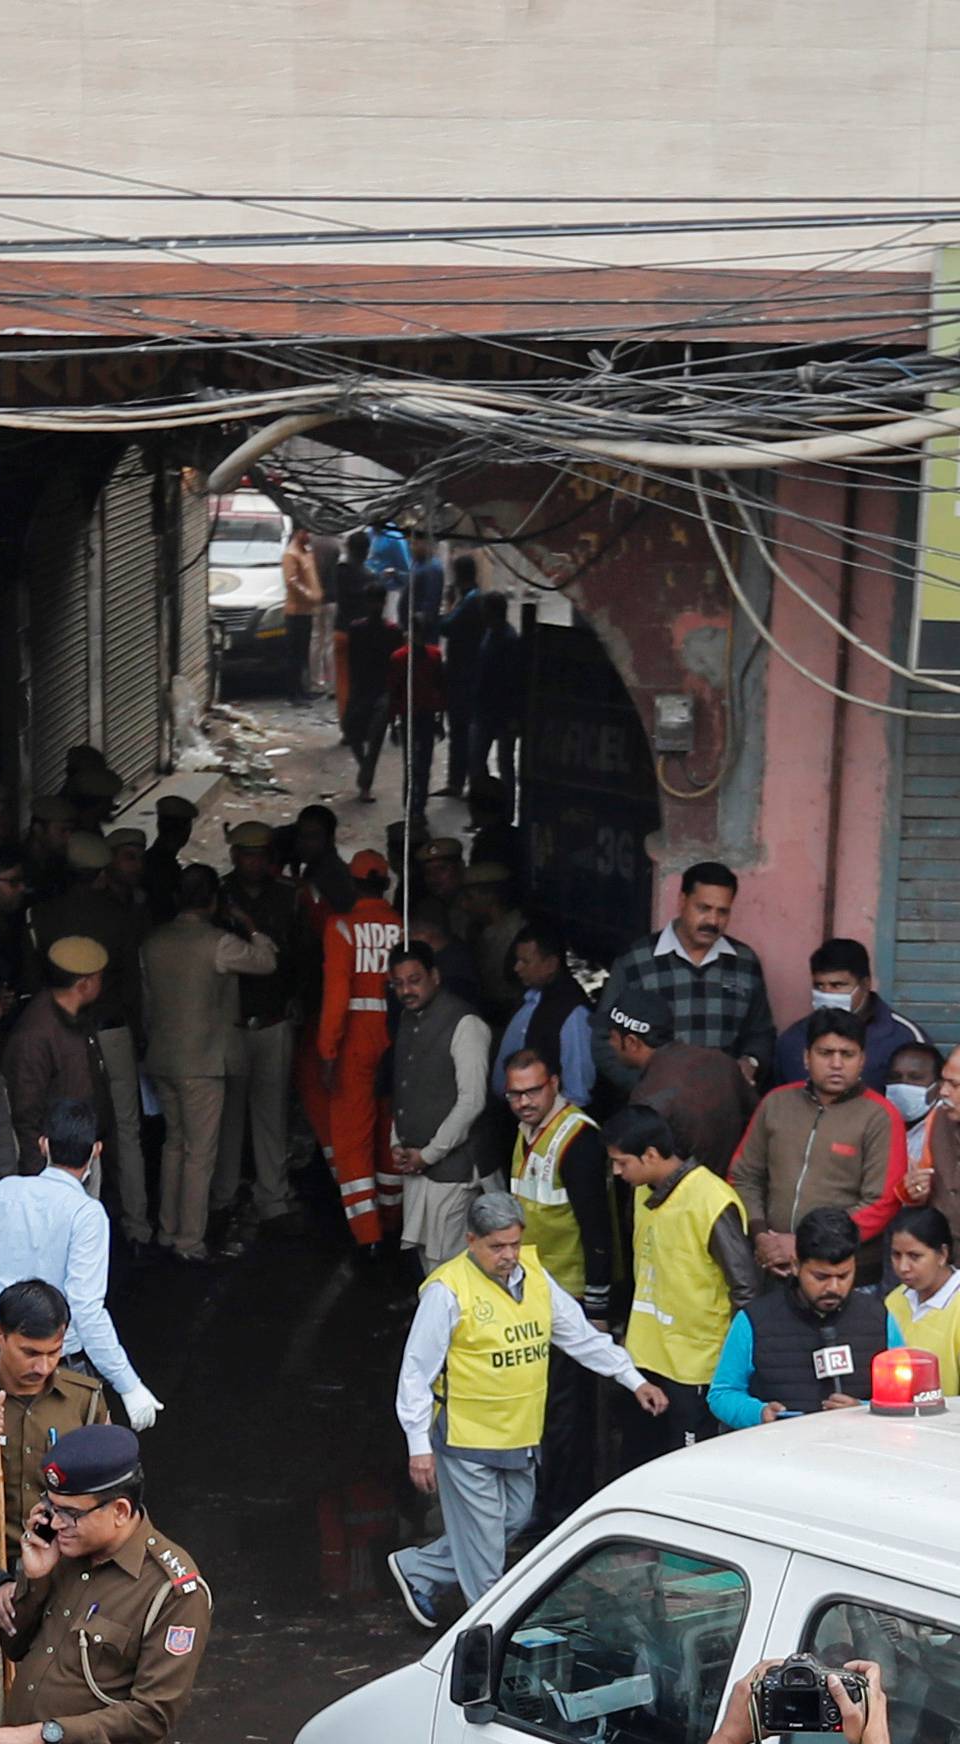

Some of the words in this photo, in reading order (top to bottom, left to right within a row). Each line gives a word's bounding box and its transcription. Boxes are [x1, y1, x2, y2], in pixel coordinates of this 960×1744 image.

[353, 922, 403, 950] NDR
[610, 1007, 651, 1034] LOVED
[504, 1320, 544, 1344] CIVIL
[491, 1341, 550, 1369] DEFENC
